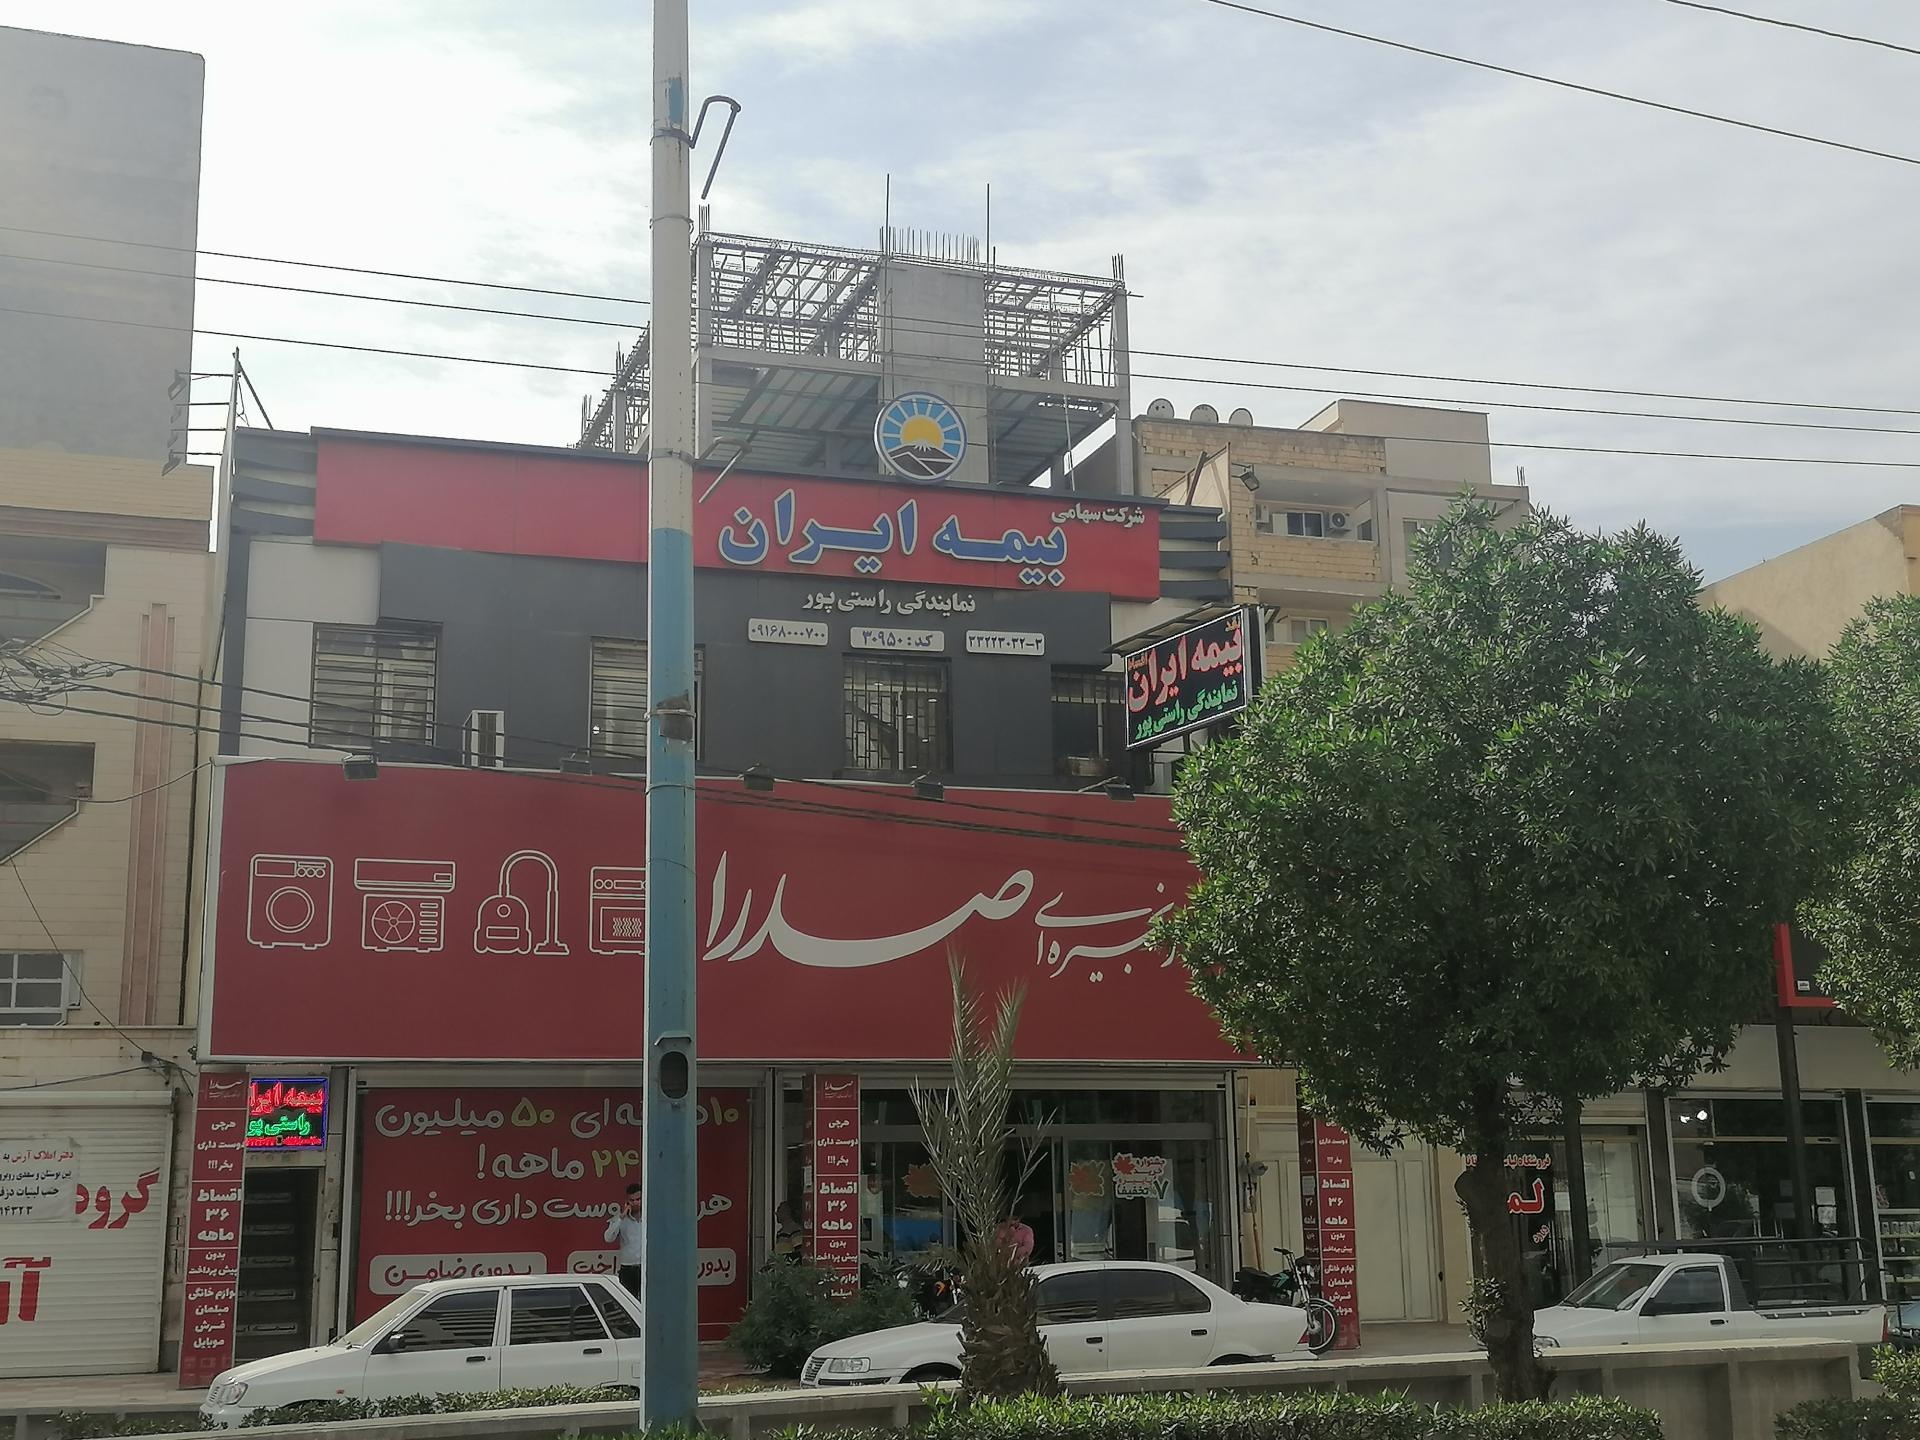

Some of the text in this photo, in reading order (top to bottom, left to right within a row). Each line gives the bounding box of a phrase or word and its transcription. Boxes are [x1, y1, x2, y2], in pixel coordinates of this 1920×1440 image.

[1051, 502, 1145, 528] شرکت سهامی
[718, 488, 1067, 587] بیمه ایران
[802, 589, 976, 617] نمایندگی راستی پور
[751, 624, 826, 639] ۰۹۱۶۸۰۰۰۷۰۰
[1128, 628, 1242, 713] بیمه ایران
[1135, 679, 1238, 740] نمایندگی راستی پور
[702, 850, 1034, 968] صدرا
[248, 1081, 283, 1116] ایرا
[374, 1098, 504, 1138] میلیون
[510, 1097, 556, 1127] ۵۰
[246, 1112, 311, 1137] راستی پو
[592, 1148, 641, 1178] ۲۴
[820, 1181, 858, 1194] اقساط
[1322, 1179, 1350, 1189] اقساط
[471, 1193, 538, 1226] داری
[543, 1198, 622, 1222] وست
[827, 1199, 848, 1213] ۳۶
[1328, 1197, 1343, 1207] ۳۶
[205, 1207, 230, 1222] ۳۶
[1325, 1215, 1348, 1225] ماهه
[821, 1218, 853, 1231] ماهه
[197, 1228, 235, 1242] ماهه
[829, 1239, 847, 1249] بدون
[205, 1250, 226, 1261] بدون
[697, 1256, 732, 1279] بدو
[195, 1304, 230, 1315] مبلمان
[194, 1319, 226, 1333] فرش
[193, 1336, 225, 1349] موبایل
